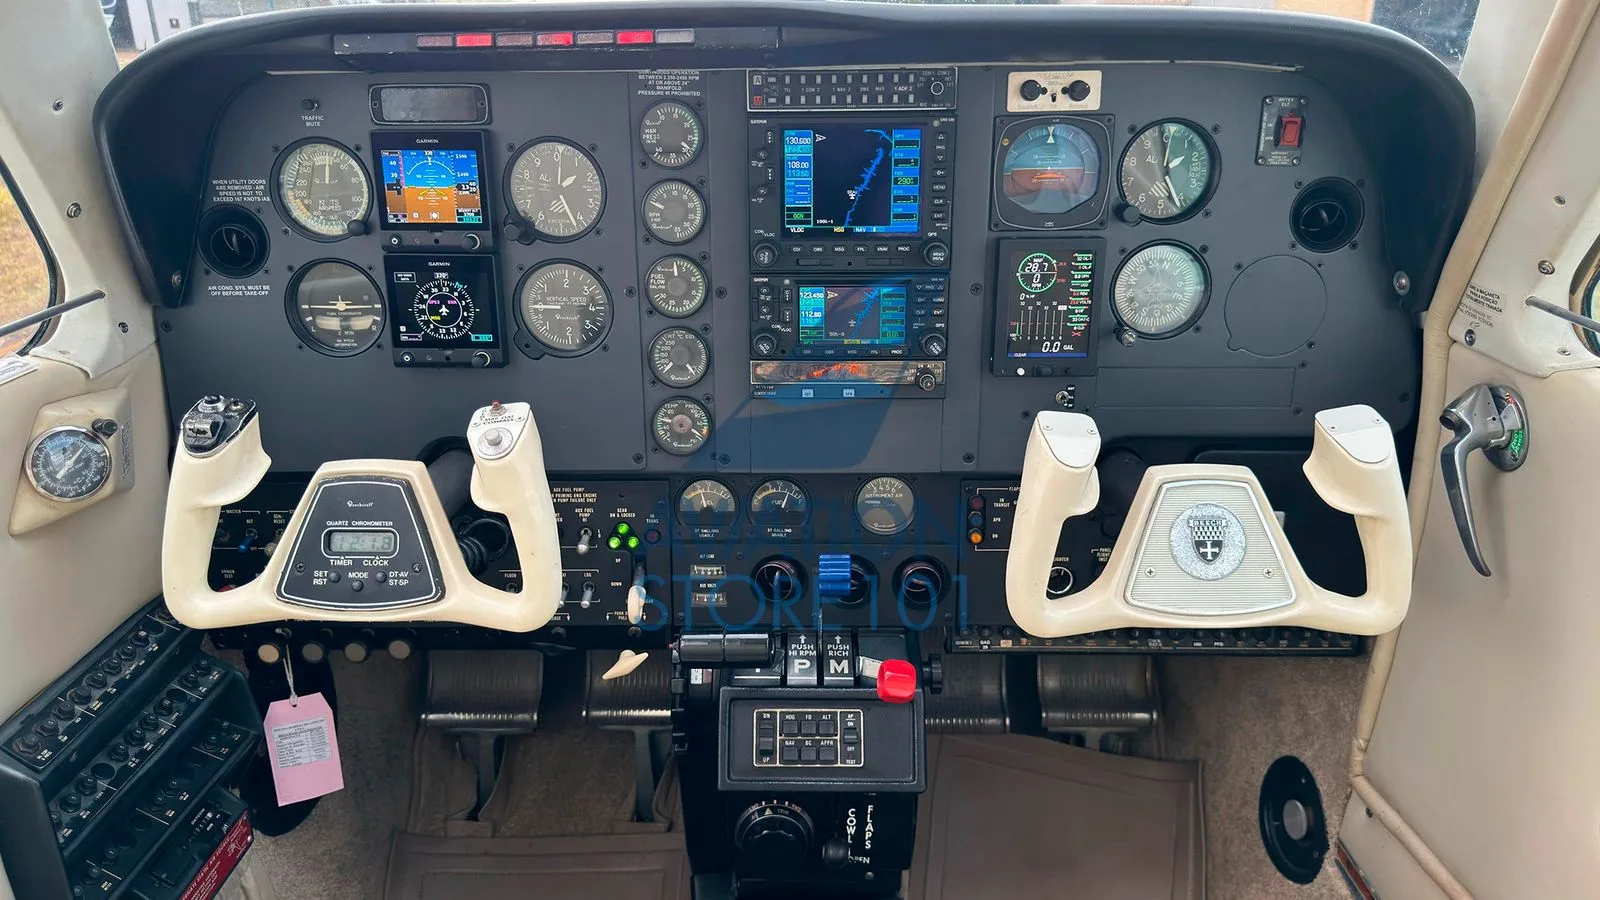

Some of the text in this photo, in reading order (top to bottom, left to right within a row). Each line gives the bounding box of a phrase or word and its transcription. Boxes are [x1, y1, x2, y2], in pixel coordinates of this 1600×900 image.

[534, 158, 540, 166] 9
[523, 170, 529, 180] 8
[587, 173, 593, 182] 2
[588, 199, 594, 208] 3
[1158, 200, 1164, 208] 5
[538, 212, 544, 220] 6
[1025, 263, 1048, 272] 28.7
[564, 278, 569, 288] 2
[1033, 274, 1040, 283] 0
[584, 286, 589, 295] 3
[566, 327, 572, 335] 2
[1042, 342, 1060, 352] 0.0
[794, 660, 810, 673] P
[830, 660, 848, 673] M
[846, 808, 856, 843] COWL
[865, 805, 874, 849] FLAPS
